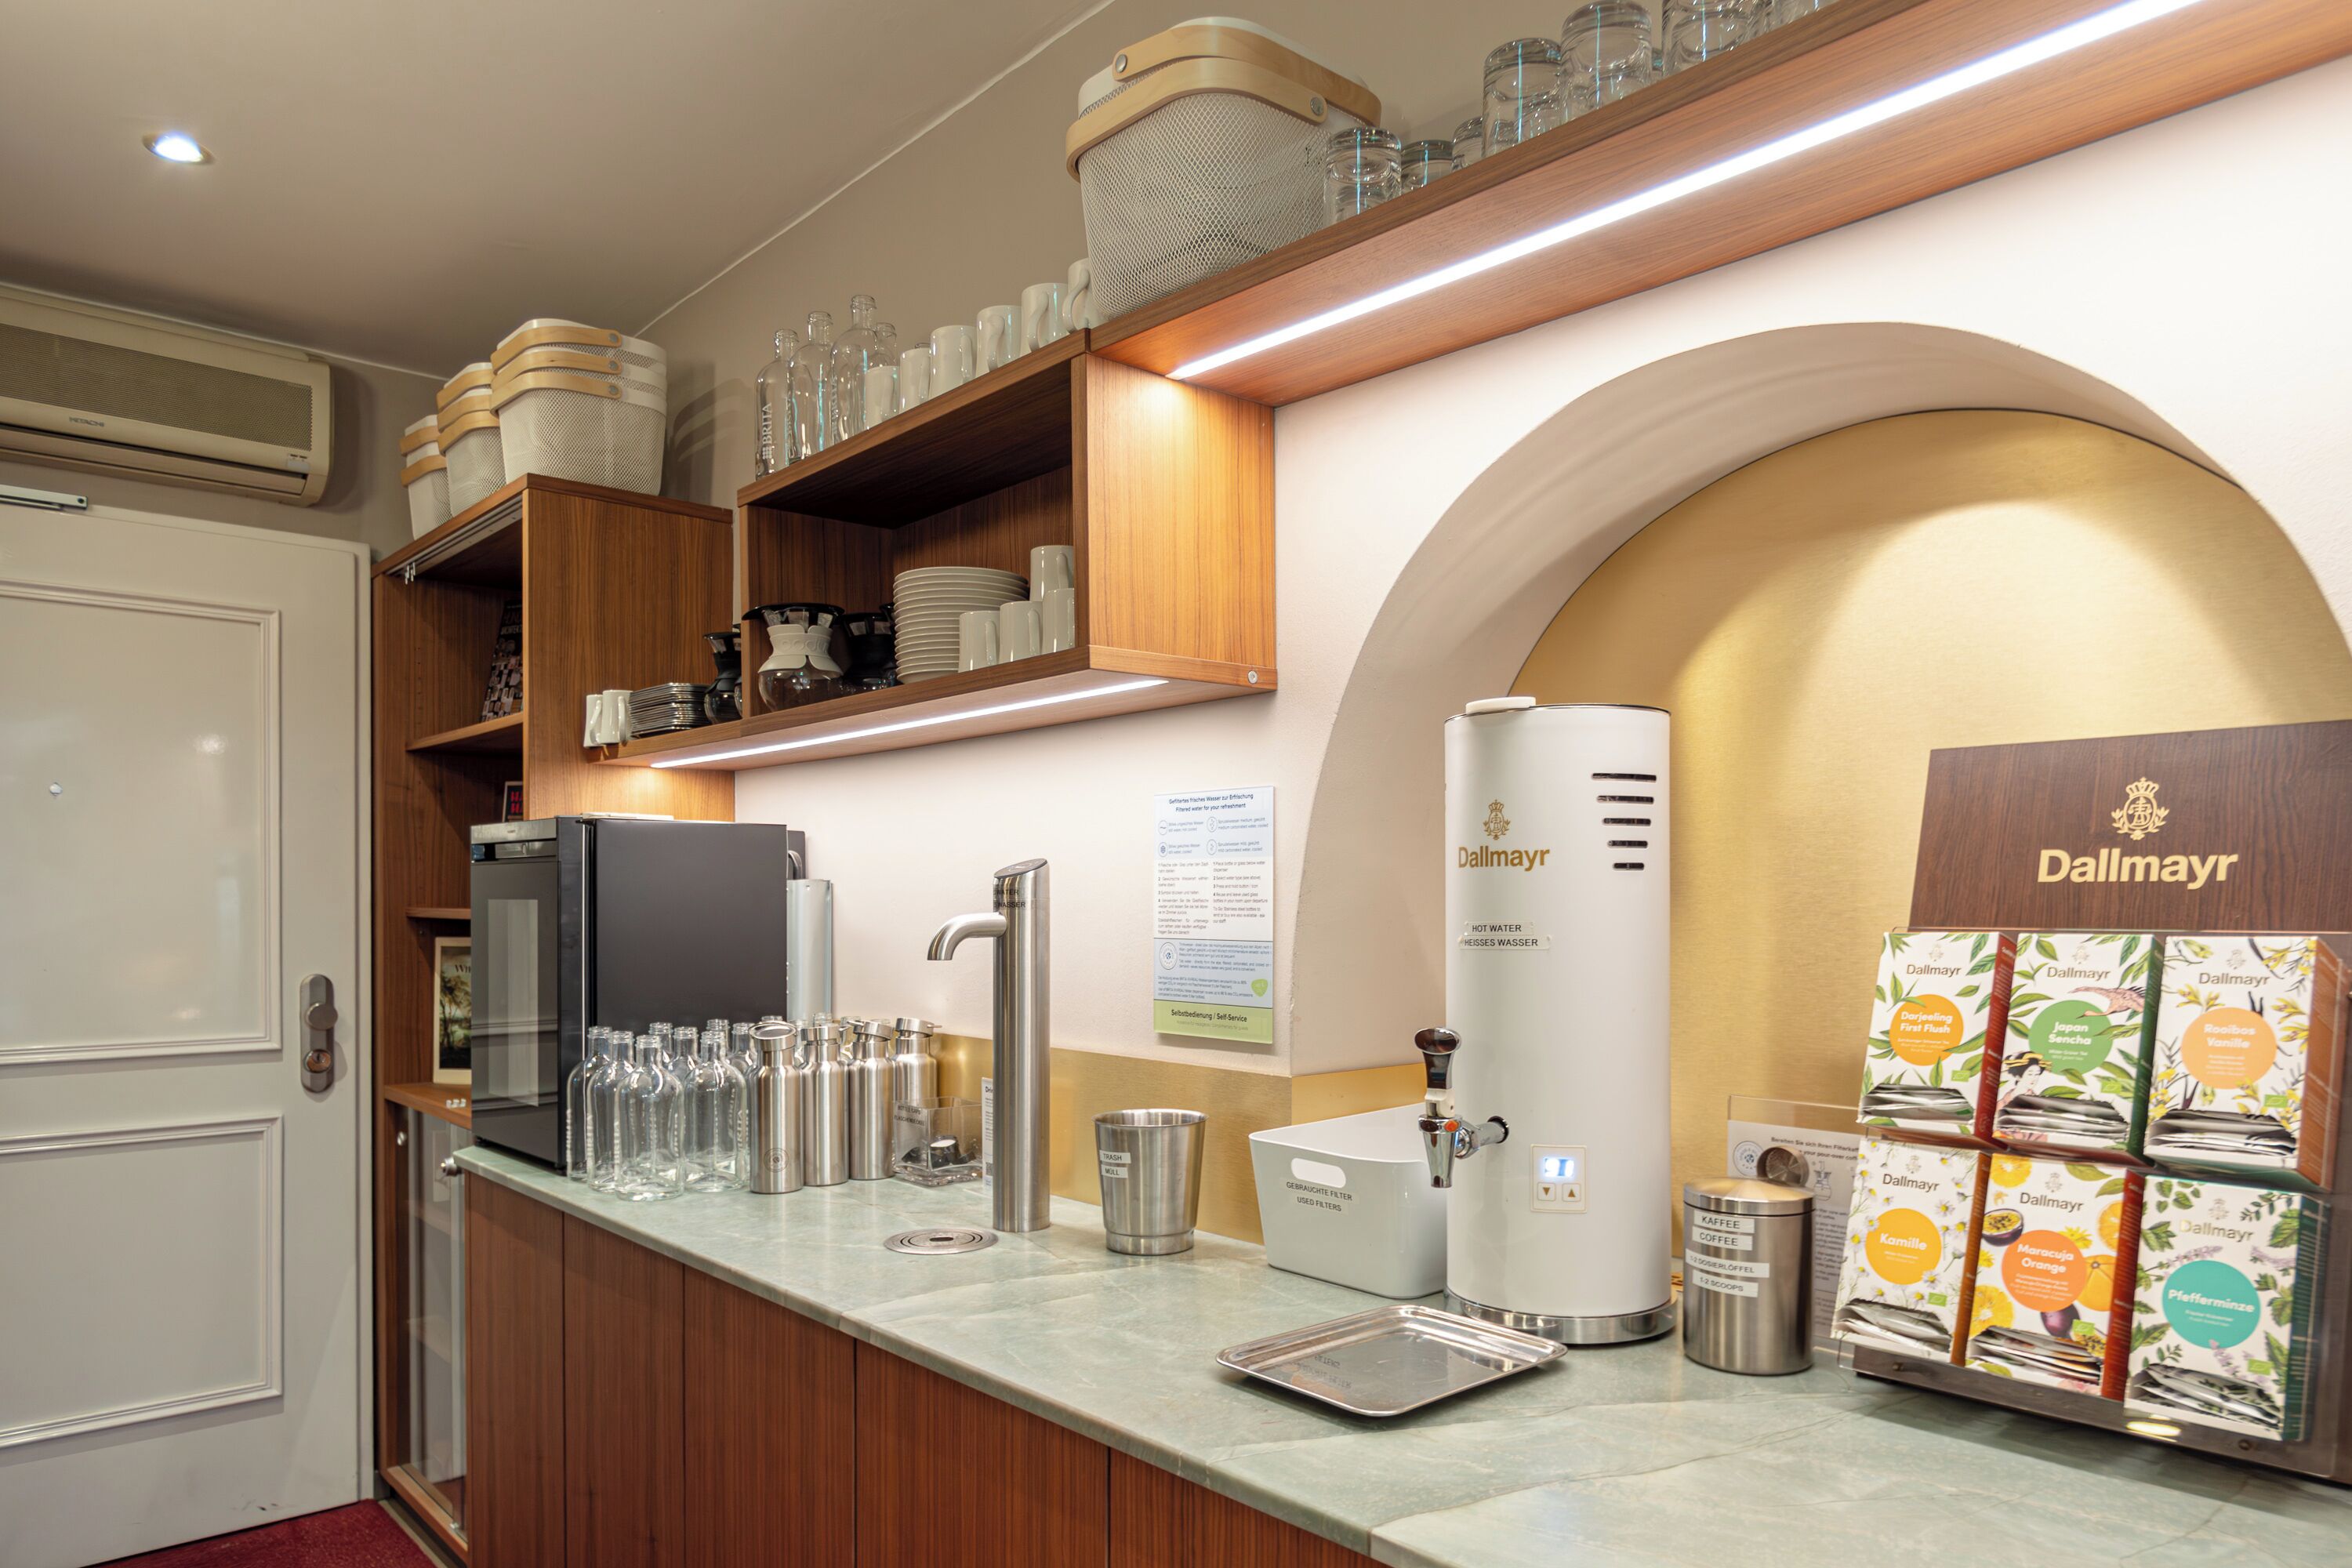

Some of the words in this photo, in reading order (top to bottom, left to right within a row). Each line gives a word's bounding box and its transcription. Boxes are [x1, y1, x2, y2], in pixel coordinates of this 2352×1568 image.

[762, 402, 771, 445] BRITA
[1458, 846, 1550, 872] Dallmayr
[2038, 848, 2238, 890] Dallmayr
[1906, 964, 1962, 978] Dallmayr
[2047, 967, 2111, 981] Dallmayr
[2198, 972, 2270, 988] Dallmayr
[1171, 1009, 1212, 1021] Selbstbedienung
[1217, 1013, 1247, 1022] Self-Service
[1900, 1011, 1953, 1024] Darjeeling
[1900, 1023, 1922, 1032] First
[1924, 1023, 1951, 1033] Flush
[2053, 1022, 2089, 1033] Japan
[2048, 1034, 2092, 1045] Sencha
[2206, 1037, 2250, 1048] Vanille
[1287, 1181, 1329, 1196] GEBRAUCHTE
[1330, 1190, 1352, 1201] FILTER
[1882, 1174, 1940, 1192] Dallmayr
[1297, 1196, 1315, 1206] USED
[1316, 1200, 1341, 1212] FILTERS
[2020, 1192, 2085, 1213] Dallmayr
[1701, 1216, 1740, 1229] KAFFEE
[2180, 1219, 2254, 1243] Dallmayr
[1700, 1232, 1738, 1247] COFFEE
[1880, 1232, 1927, 1250] Kamille
[2016, 1243, 2074, 1262] Maracuja
[1698, 1258, 1755, 1273] DOSIERLÖFFEL
[2021, 1257, 2067, 1275] Orange
[1710, 1279, 1744, 1292] SCOOPS
[2168, 1289, 2255, 1313] Pfefferminze
